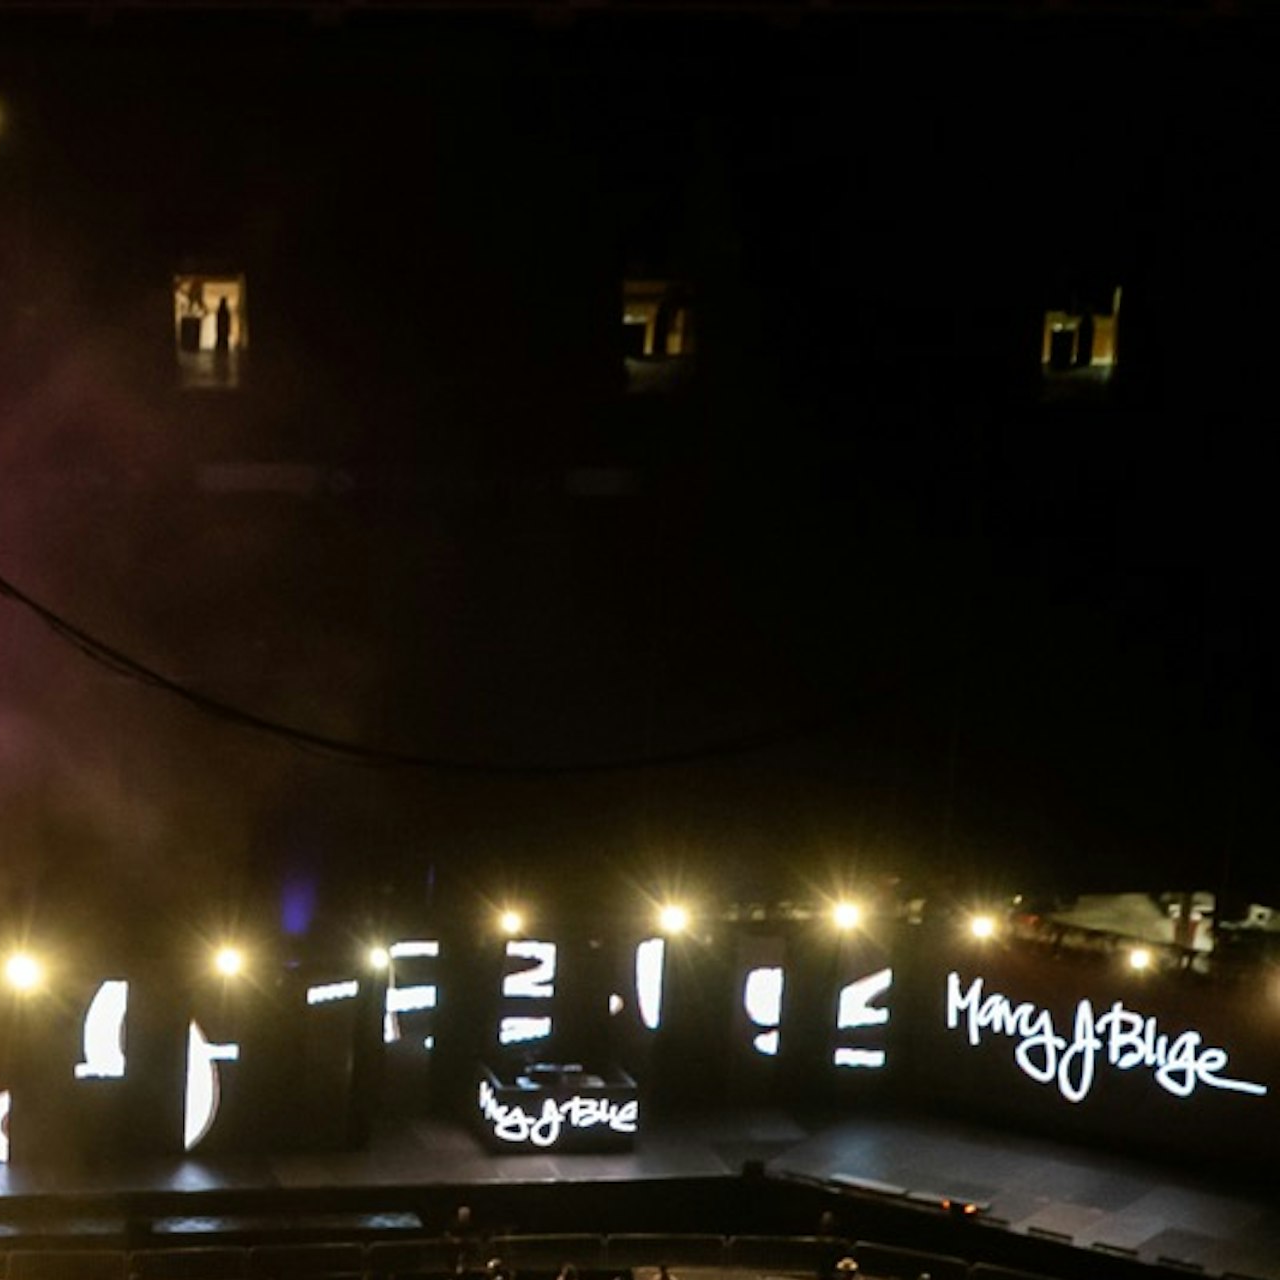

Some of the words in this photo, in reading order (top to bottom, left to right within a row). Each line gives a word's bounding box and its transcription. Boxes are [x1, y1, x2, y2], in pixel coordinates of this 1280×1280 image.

[947, 971, 1067, 1083] Mary
[1057, 999, 1103, 1102] J
[1095, 1001, 1267, 1096] Blige
